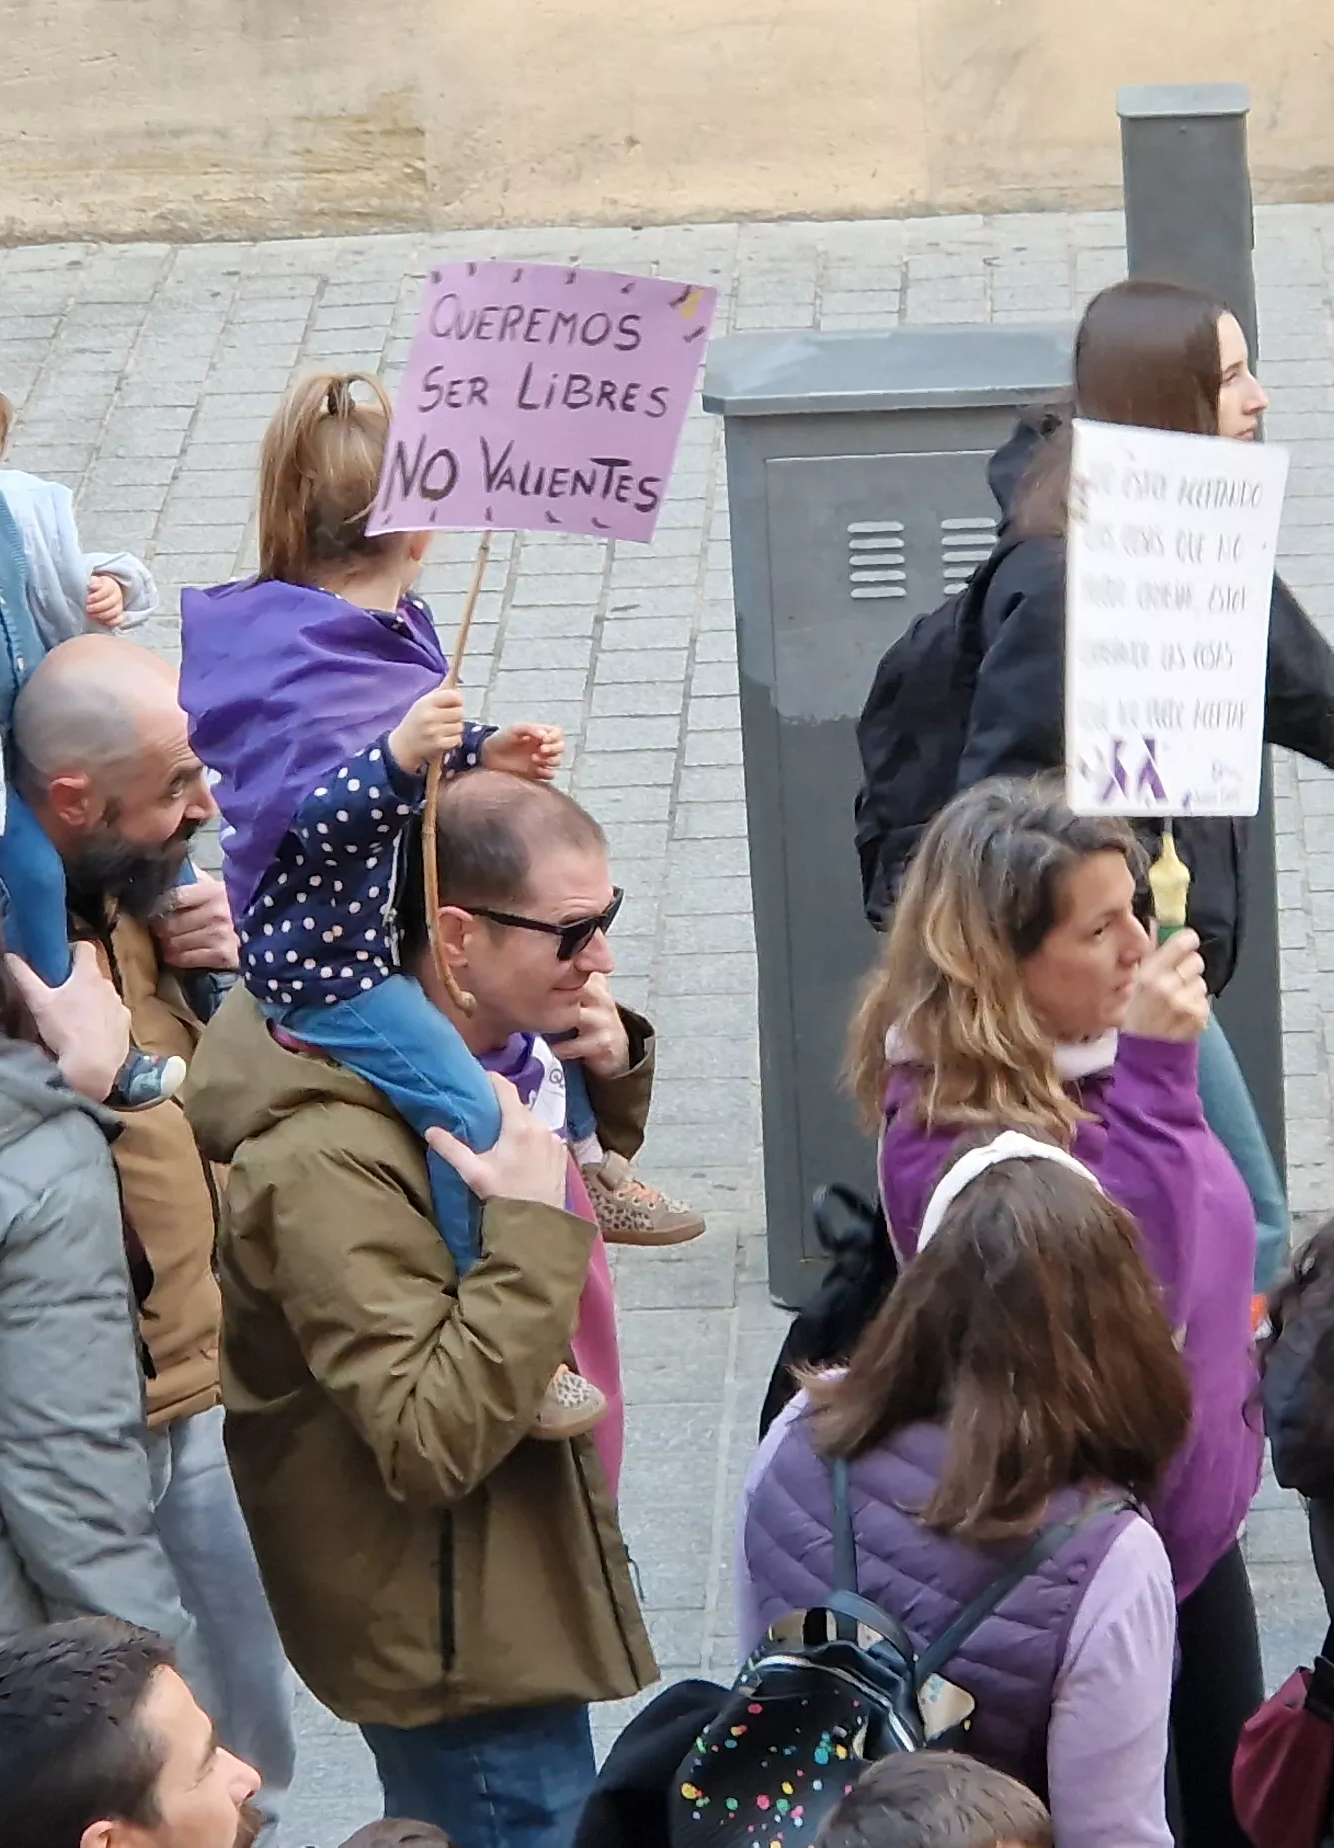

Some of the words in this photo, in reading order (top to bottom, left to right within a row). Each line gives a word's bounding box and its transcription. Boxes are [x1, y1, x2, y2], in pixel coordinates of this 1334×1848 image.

[429, 292, 643, 352] QUEREMOS
[418, 364, 490, 413] SER
[382, 433, 459, 512] NO
[479, 434, 662, 513] VALIENTES
